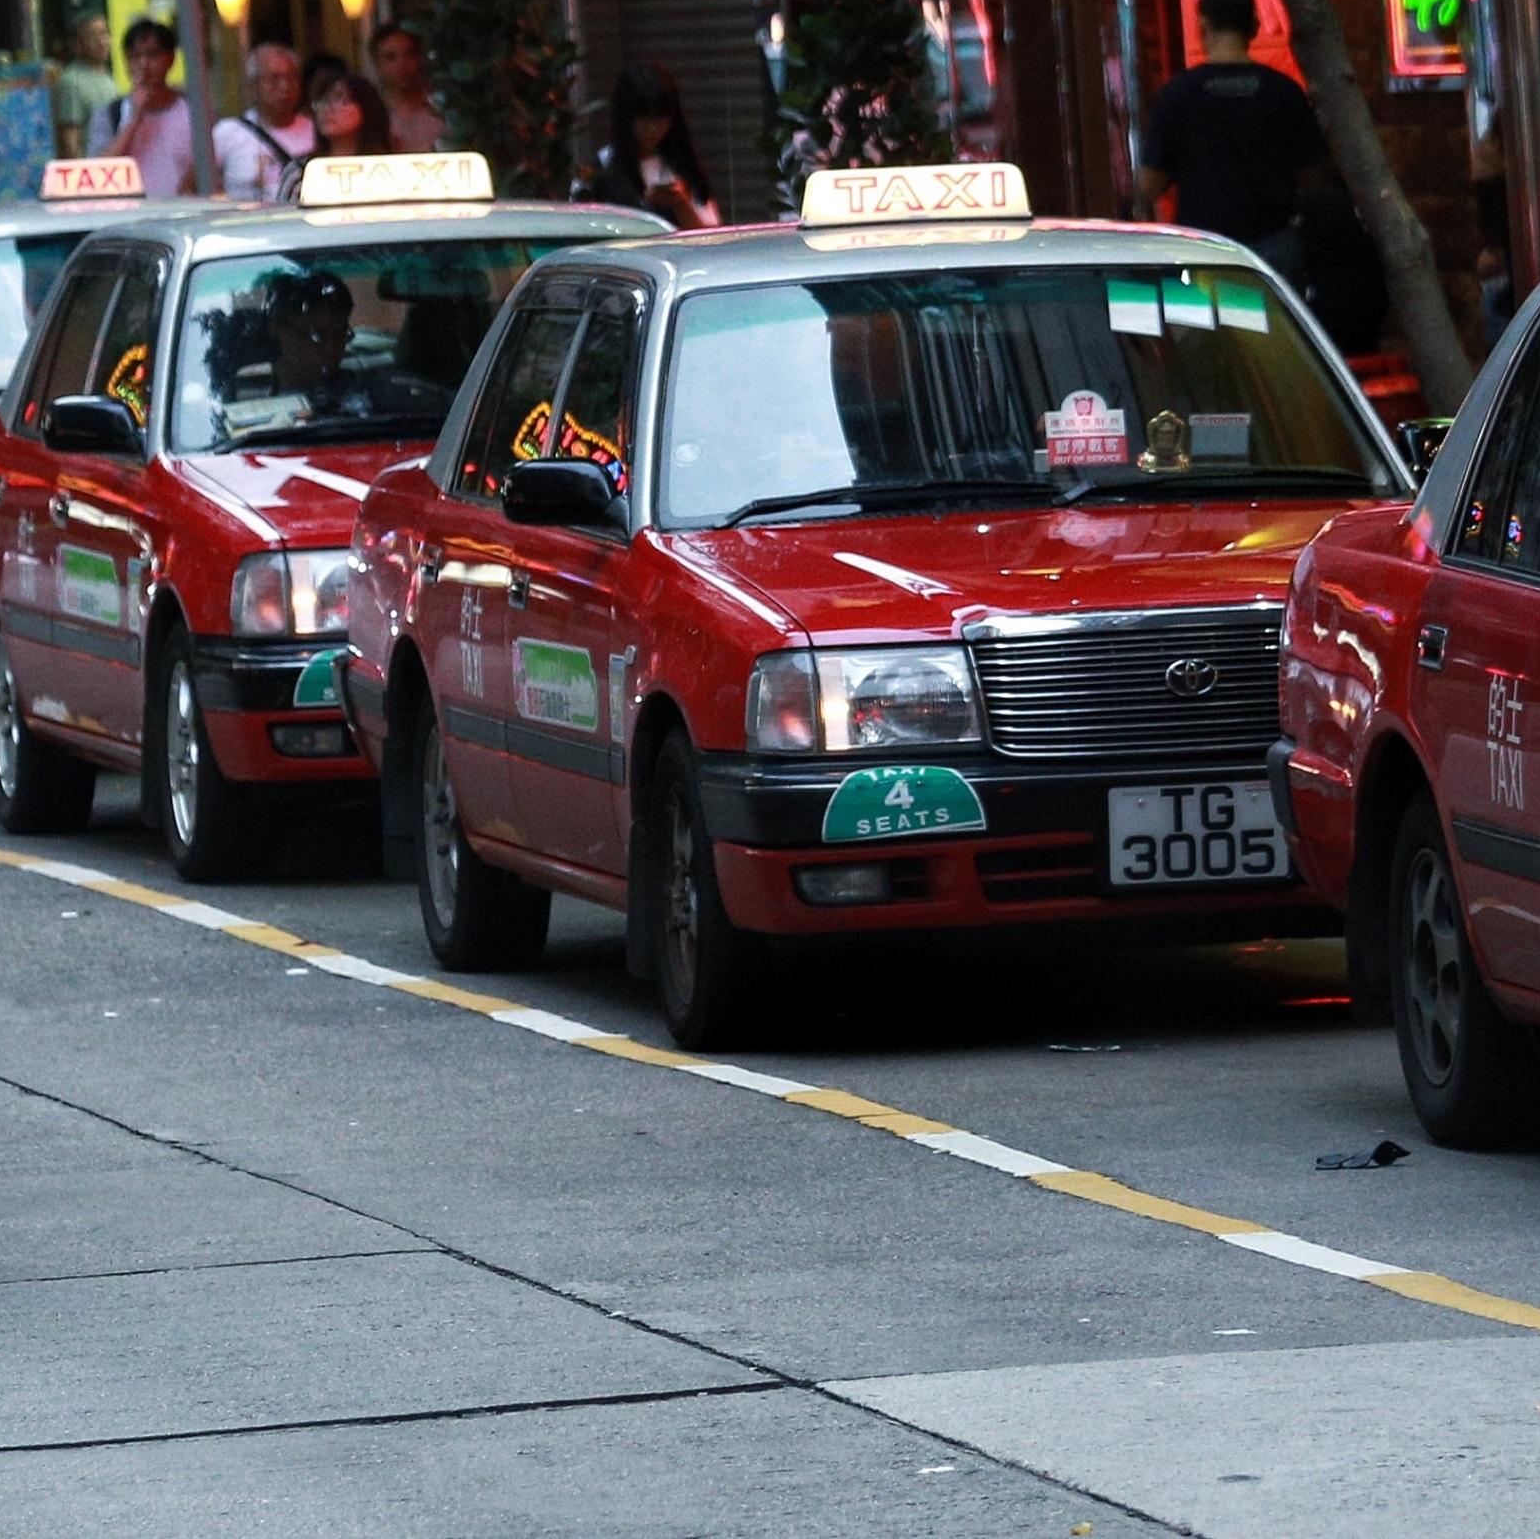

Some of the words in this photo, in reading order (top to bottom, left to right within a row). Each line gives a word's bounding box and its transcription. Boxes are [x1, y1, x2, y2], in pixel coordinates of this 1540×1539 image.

[55, 165, 133, 193] TAXI
[325, 159, 471, 196] TAXI
[833, 170, 1007, 213] TAXI
[1487, 673, 1524, 745] 的士
[883, 779, 915, 810] 4
[1486, 740, 1524, 811] TAXI
[856, 806, 951, 836] SEATS
[1161, 784, 1235, 834] TG
[1122, 827, 1277, 882] 3005
